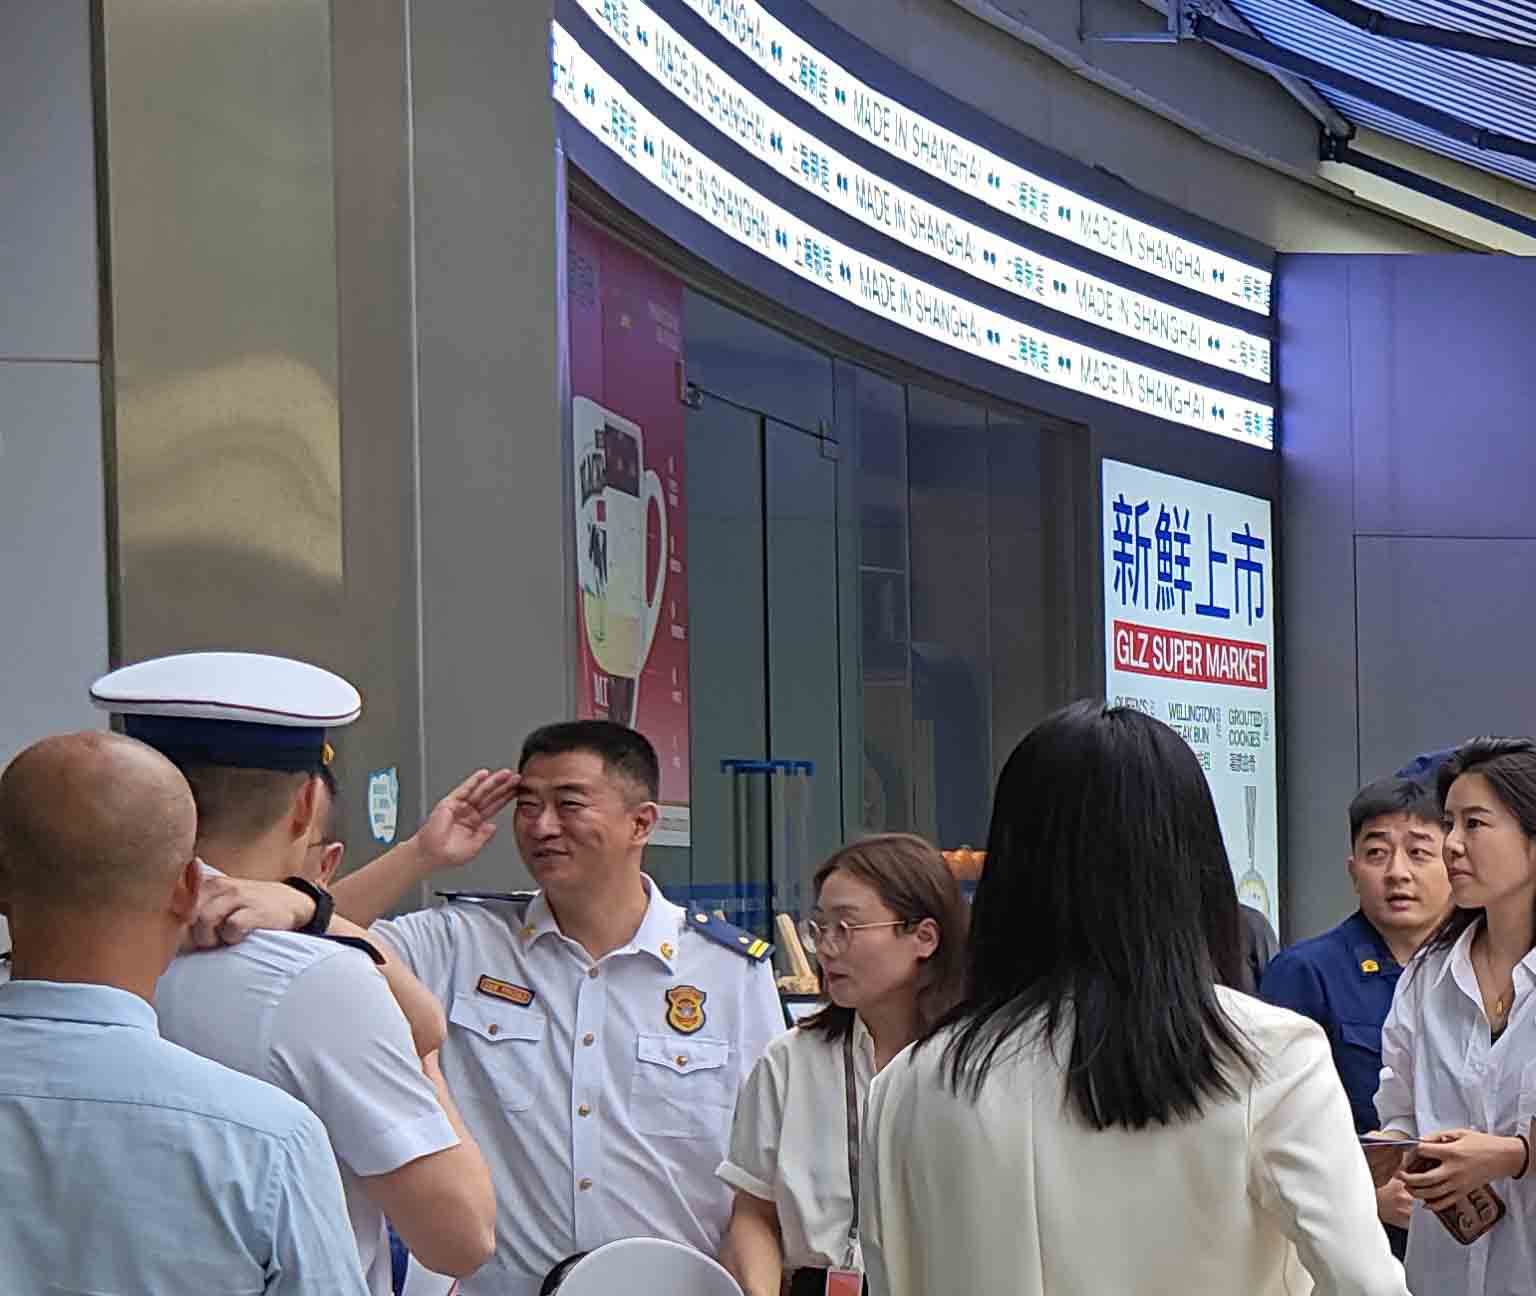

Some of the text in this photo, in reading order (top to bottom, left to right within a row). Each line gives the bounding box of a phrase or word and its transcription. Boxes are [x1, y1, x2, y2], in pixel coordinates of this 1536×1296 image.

[853, 90, 891, 142] MADE
[855, 175, 891, 226] MADE
[1079, 209, 1119, 251] MADE
[859, 263, 898, 314] MADE
[1075, 279, 1114, 323] MADE
[1080, 355, 1119, 396] MADE
[1112, 494, 1265, 626] 新鮮上市
[1116, 629, 1265, 683] GLZ SUPER MARKET
